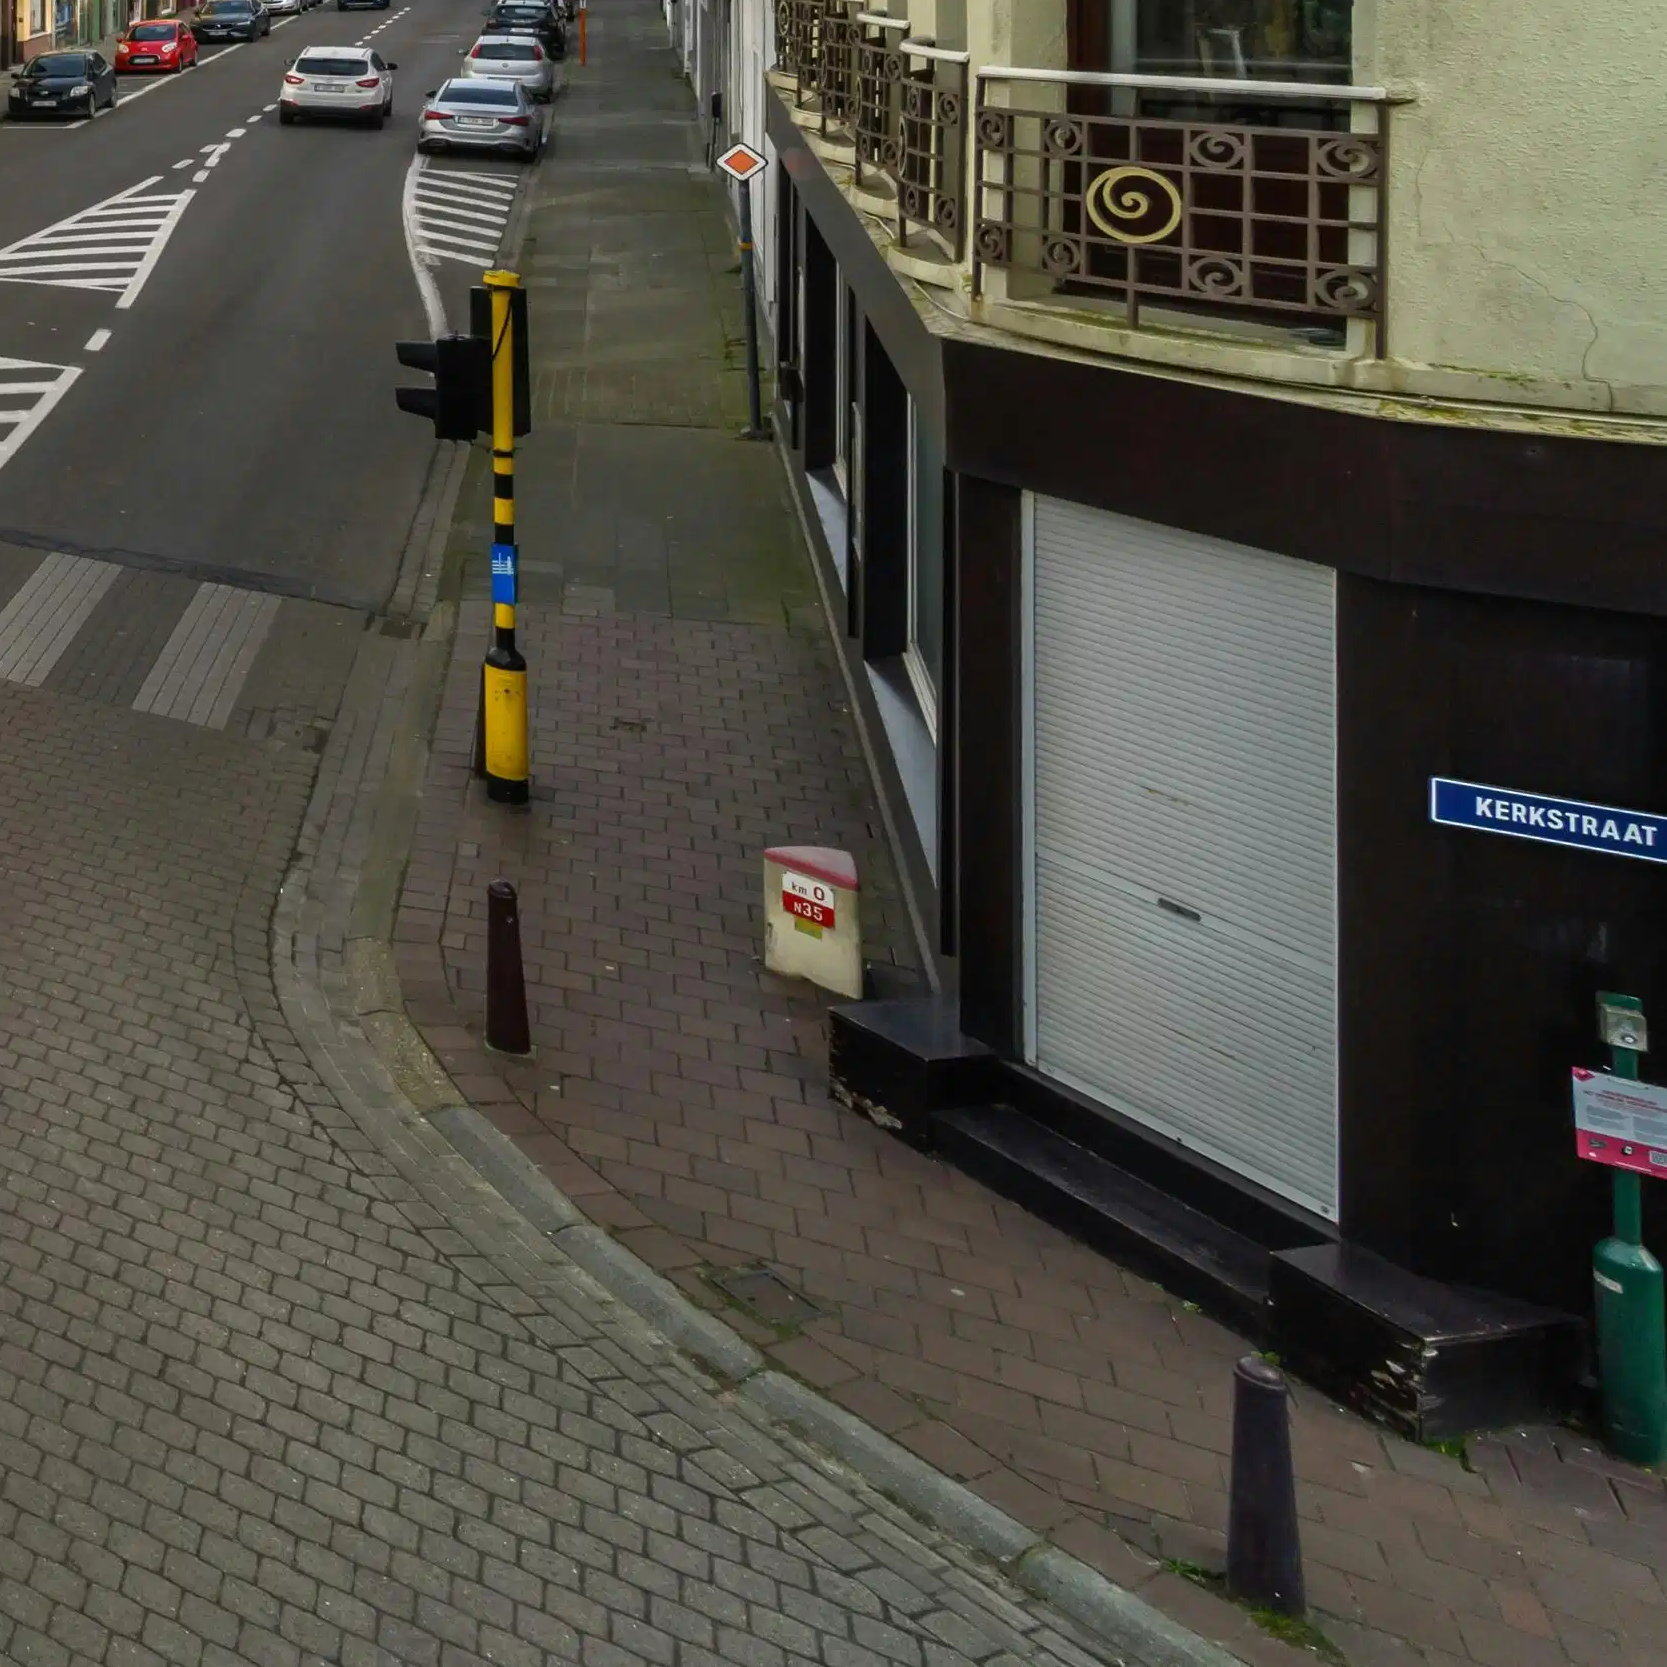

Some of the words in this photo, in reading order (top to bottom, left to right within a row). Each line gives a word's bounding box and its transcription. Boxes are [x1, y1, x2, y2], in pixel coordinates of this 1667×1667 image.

[1475, 796, 1657, 847] KERKSTRAAT
[791, 881, 807, 896] km
[813, 886, 825, 901] 0
[793, 901, 823, 921] N35
